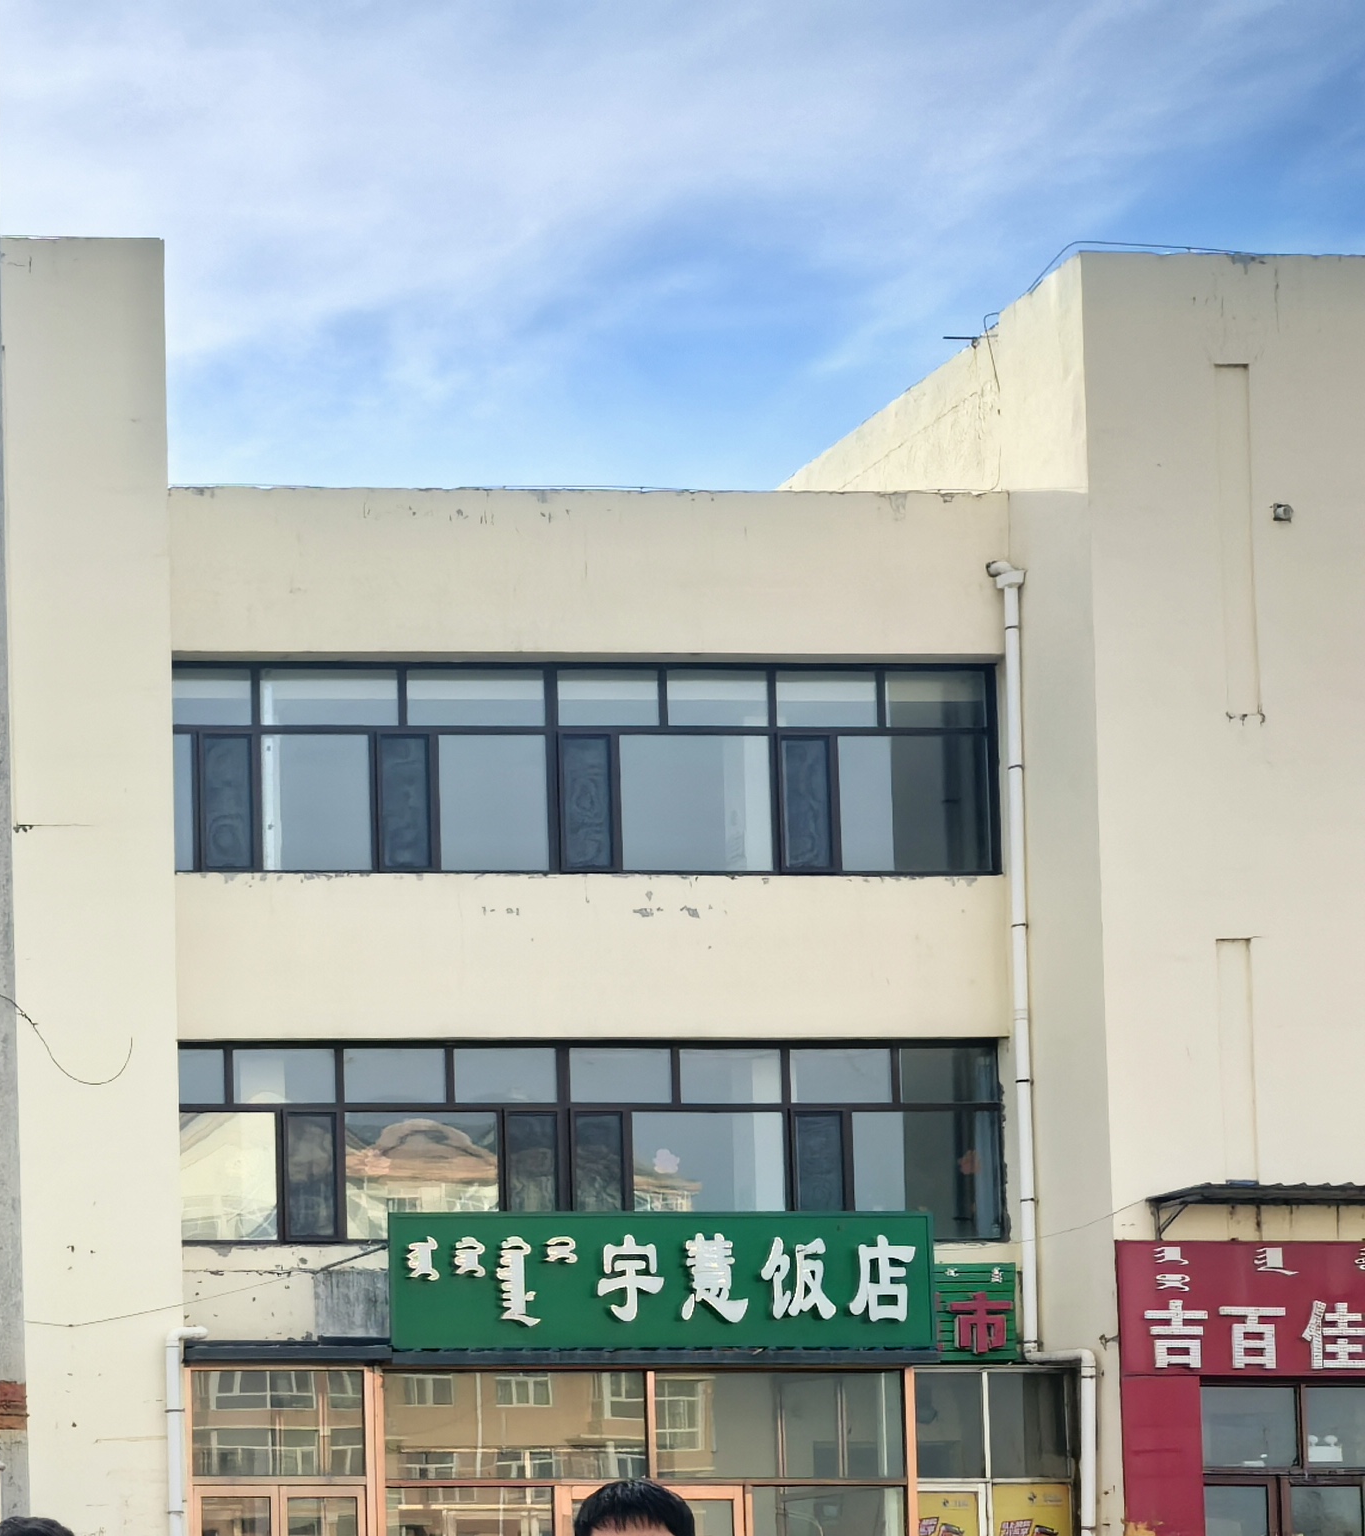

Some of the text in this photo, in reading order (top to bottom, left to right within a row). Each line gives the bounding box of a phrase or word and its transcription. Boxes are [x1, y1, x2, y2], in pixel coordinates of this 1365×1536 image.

[597, 1233, 916, 1323] 宇慧饭店
[937, 1291, 1014, 1353] 市
[1144, 1300, 1365, 1369] 吉百佳
